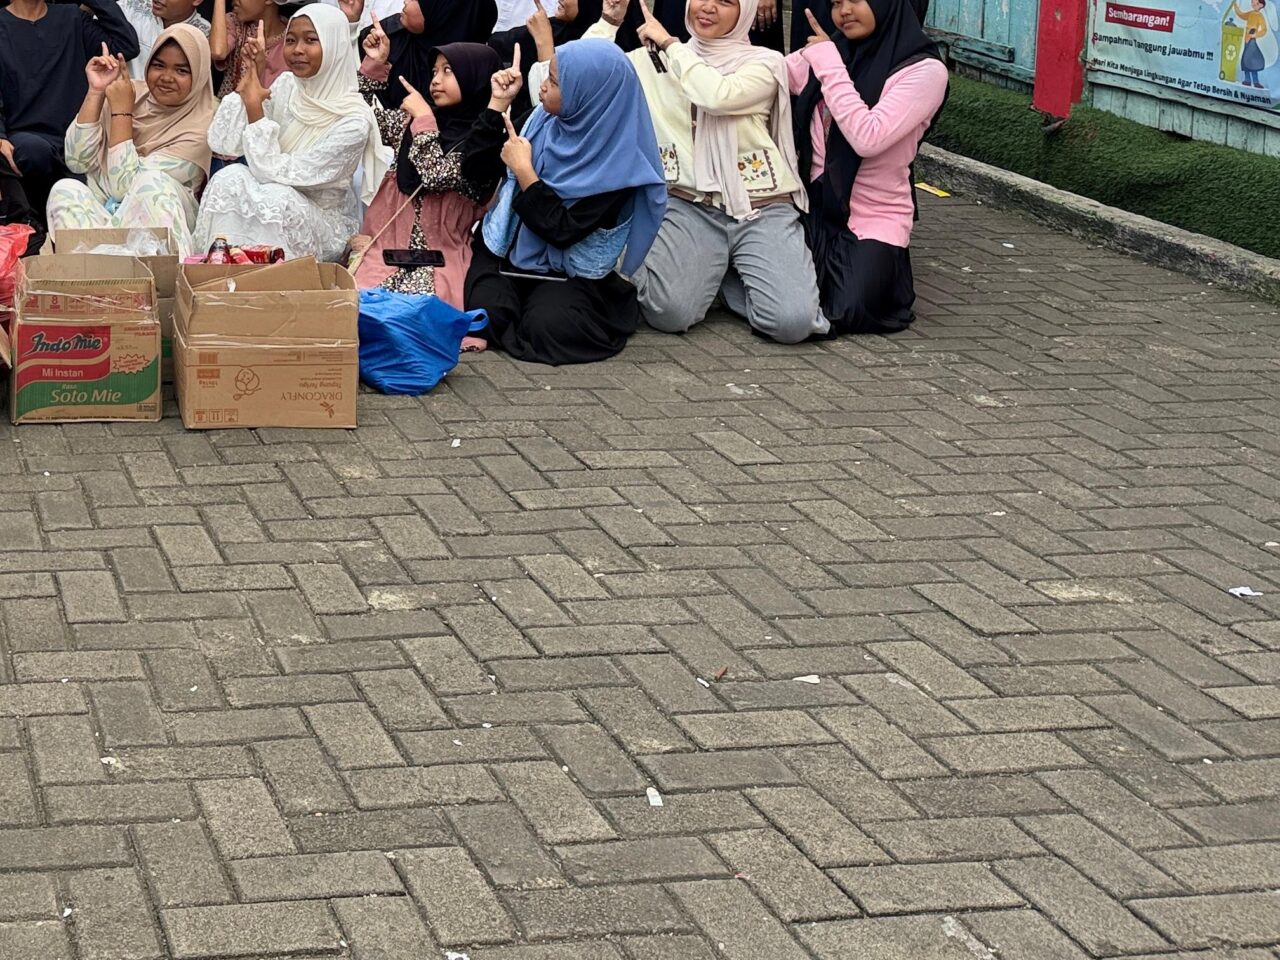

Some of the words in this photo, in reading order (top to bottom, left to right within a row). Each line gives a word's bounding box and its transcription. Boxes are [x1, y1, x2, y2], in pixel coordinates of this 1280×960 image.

[1108, 7, 1170, 27] Sembarangan!
[1093, 32, 1134, 47] Sampahmu
[1134, 39, 1167, 55] Tanggung
[1167, 44, 1205, 60] jawabmu
[1107, 61, 1119, 69] Kita
[1120, 64, 1143, 77] Menjaga
[1144, 68, 1176, 85] Lingkungan
[1177, 78, 1192, 89] Agar
[1193, 81, 1211, 93] Tetap
[1212, 85, 1233, 98] Bersih
[1240, 92, 1272, 105] Nyaman
[42, 368, 54, 377] Mi
[55, 368, 84, 377] Instan
[50, 390, 88, 403] Soto
[91, 390, 122, 403] Mie
[280, 392, 343, 401] DRAGONFLY
